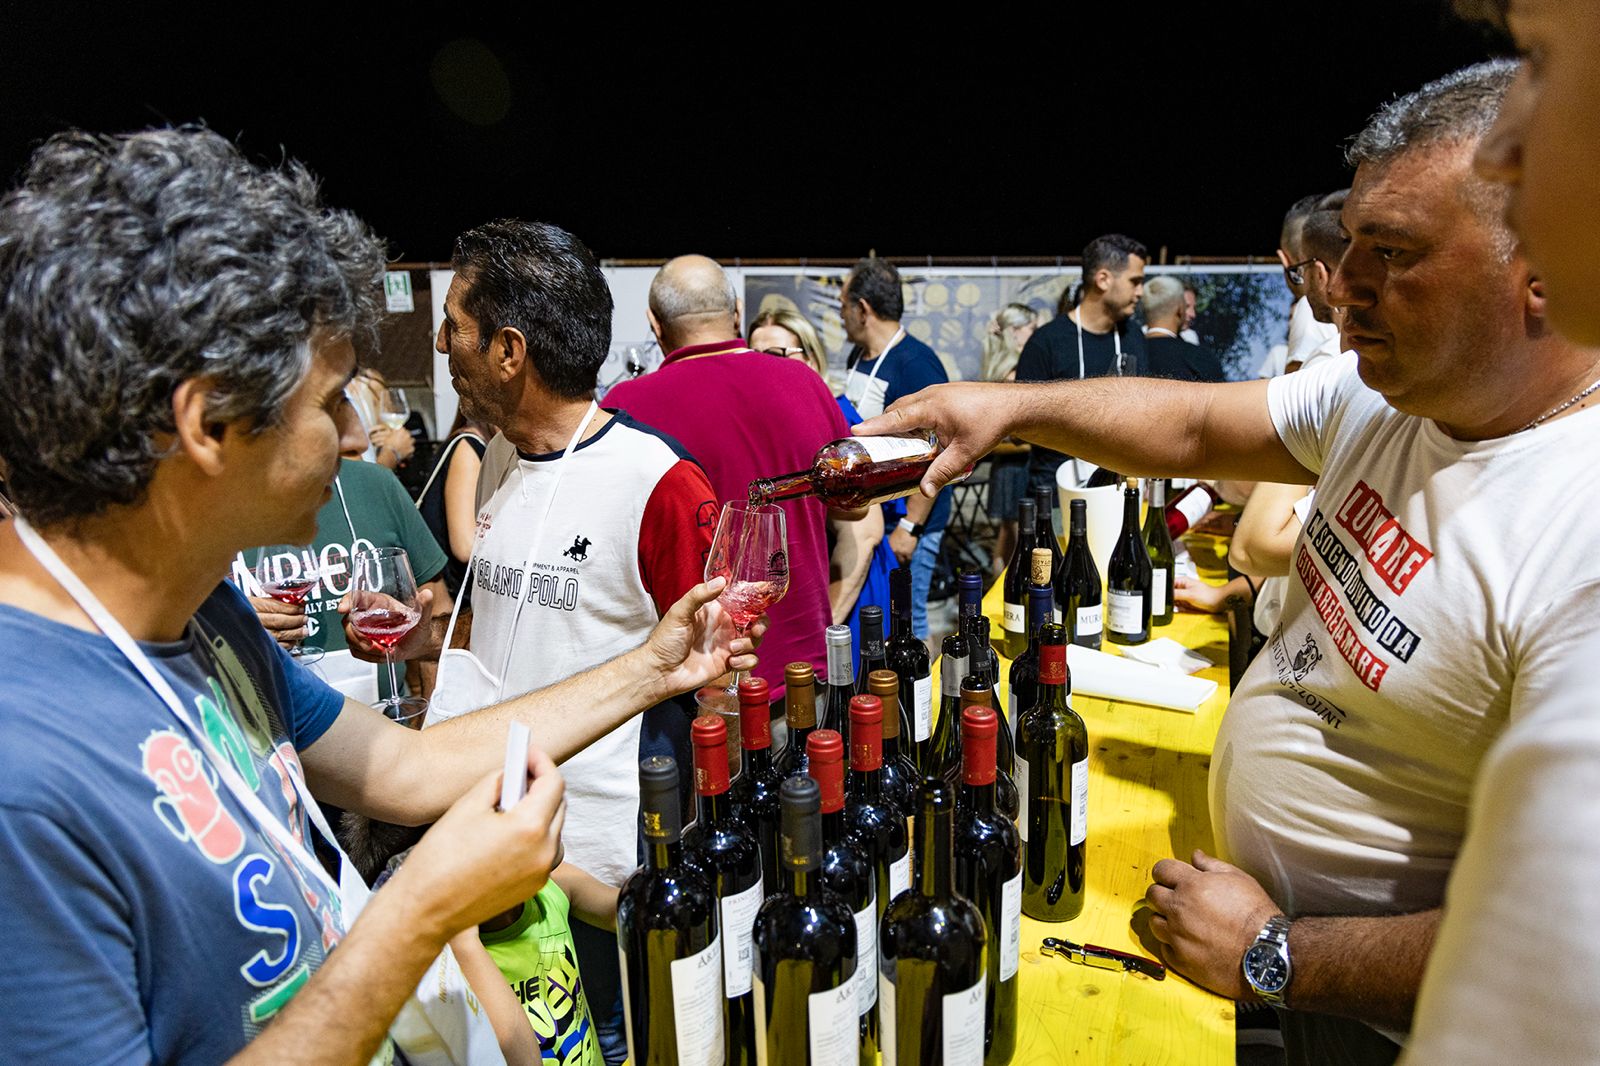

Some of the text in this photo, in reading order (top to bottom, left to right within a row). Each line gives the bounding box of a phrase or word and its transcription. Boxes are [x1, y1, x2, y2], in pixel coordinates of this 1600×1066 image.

[477, 558, 525, 600] GRAND
[527, 572, 579, 612] POLO
[1297, 548, 1336, 618] GUSTARE
[1334, 622, 1384, 688] AMARE
[1382, 622, 1415, 661] DA
